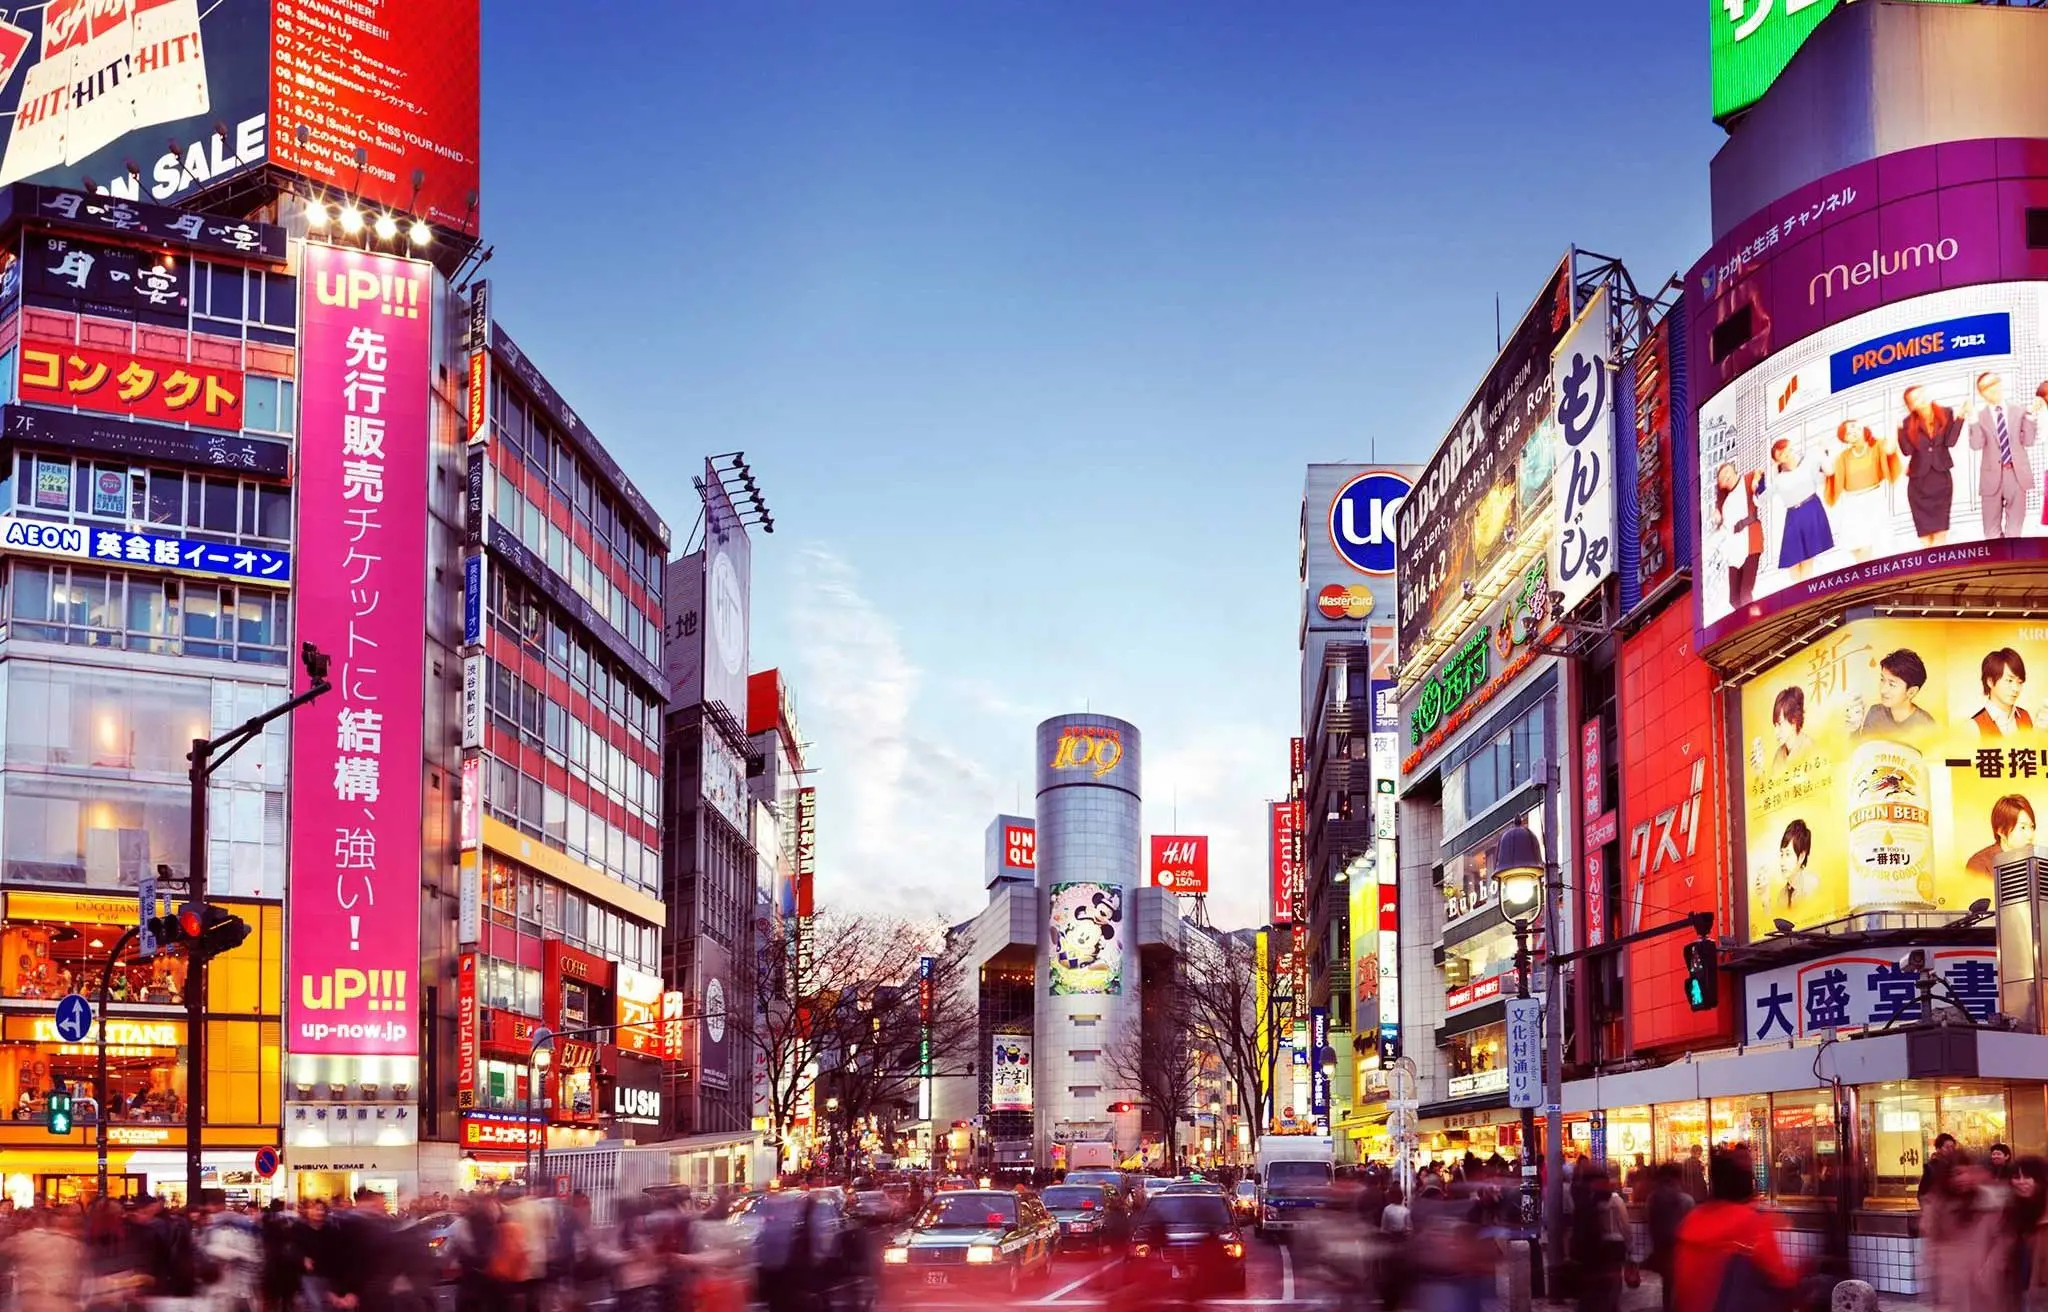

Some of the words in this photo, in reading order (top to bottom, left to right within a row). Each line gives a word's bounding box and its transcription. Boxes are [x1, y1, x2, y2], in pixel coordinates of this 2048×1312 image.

[296, 9, 327, 30] Shake
[337, 26, 353, 43] Up
[17, 84, 70, 131] HIT!
[72, 54, 132, 109] HIT!
[134, 32, 199, 75] HIT!
[152, 113, 266, 200] SALE
[358, 129, 374, 143] On
[377, 119, 401, 138] KISS
[402, 130, 433, 150] YOUR
[434, 143, 464, 163] MIND
[48, 239, 67, 252] 9F
[1718, 225, 1779, 282] わかさ生活
[1783, 187, 1856, 236] チャンネル
[1809, 238, 1958, 305] melumo
[316, 269, 419, 319] uP!!!
[1852, 331, 1944, 374] PROMISE
[1951, 333, 1986, 349] プロミス
[23, 349, 236, 414] コンタクト
[16, 416, 35, 431] 7F
[1400, 400, 1487, 552] OLDCODEX
[1504, 359, 1532, 410] ALBUM
[1454, 451, 1494, 510] within
[1497, 417, 1521, 451] the
[1557, 352, 1609, 581] もんじゃ
[6, 523, 81, 552] AEON
[97, 531, 283, 575] 英会話イーオン
[1402, 549, 1447, 630] 2014.4.2
[1808, 571, 1860, 594] WAKASA
[1865, 555, 1923, 579] SEIKATSU
[1927, 546, 1991, 565] CHANNEL
[1319, 594, 1373, 607] MasterCard
[1050, 734, 1124, 777] 109
[1894, 806, 1927, 821] BEER
[1162, 841, 1197, 864] H&M
[1275, 806, 1292, 918] Essential
[1865, 853, 1911, 866] 一番搾り
[1175, 878, 1201, 886] 150m
[561, 956, 588, 977] COFFEE
[302, 970, 406, 1013] uP!!!
[1756, 959, 2000, 1040] 大盛堂書
[302, 1021, 407, 1043] up-now.jp
[1316, 1014, 1324, 1048] MIZUHO
[1512, 1008, 1528, 1090] 文化村通り
[615, 1087, 660, 1117] LUSH
